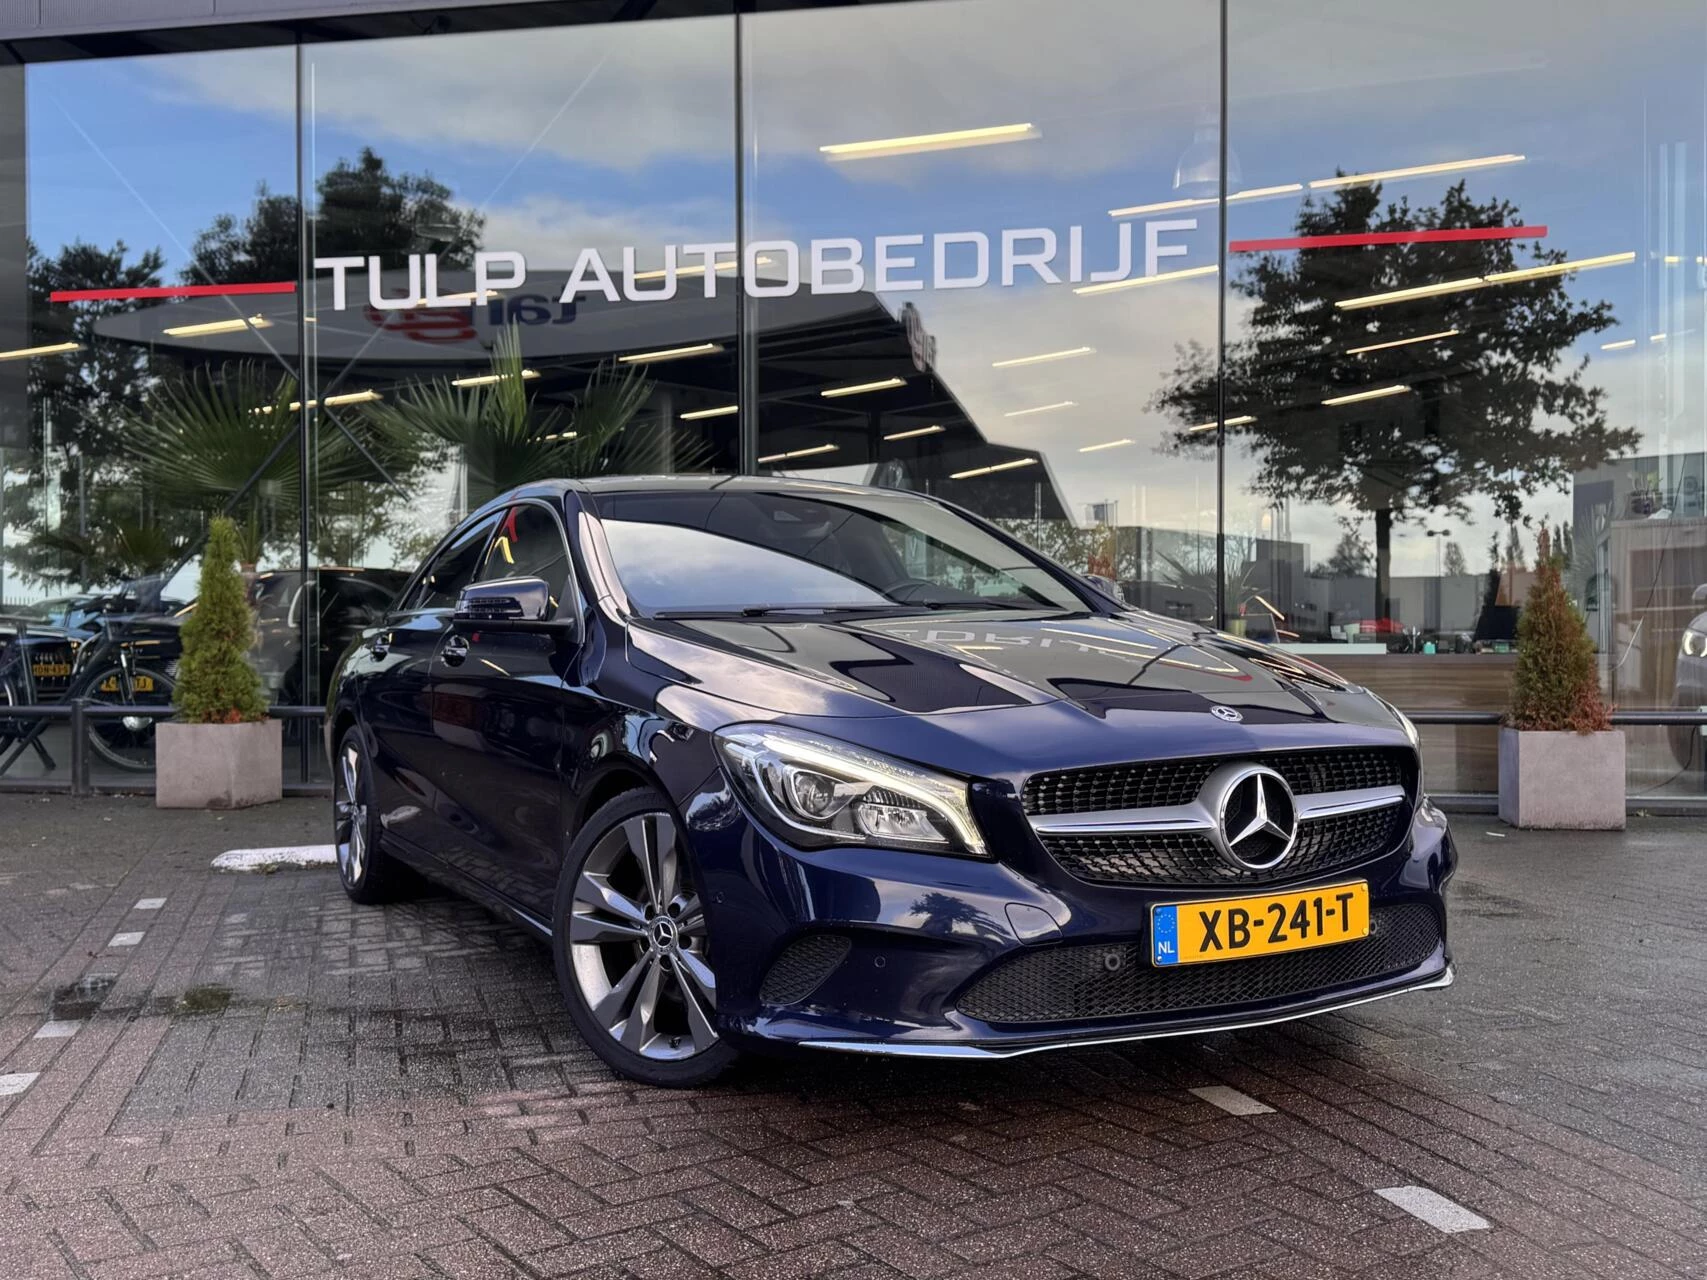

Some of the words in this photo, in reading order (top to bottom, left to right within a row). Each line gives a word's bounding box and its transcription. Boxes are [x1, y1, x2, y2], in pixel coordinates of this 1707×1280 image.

[314, 251, 527, 311] TULP
[559, 219, 1198, 304] AUTOBEDRIJF
[1157, 941, 1175, 955] NL
[1199, 892, 1354, 953] XB-241-T
